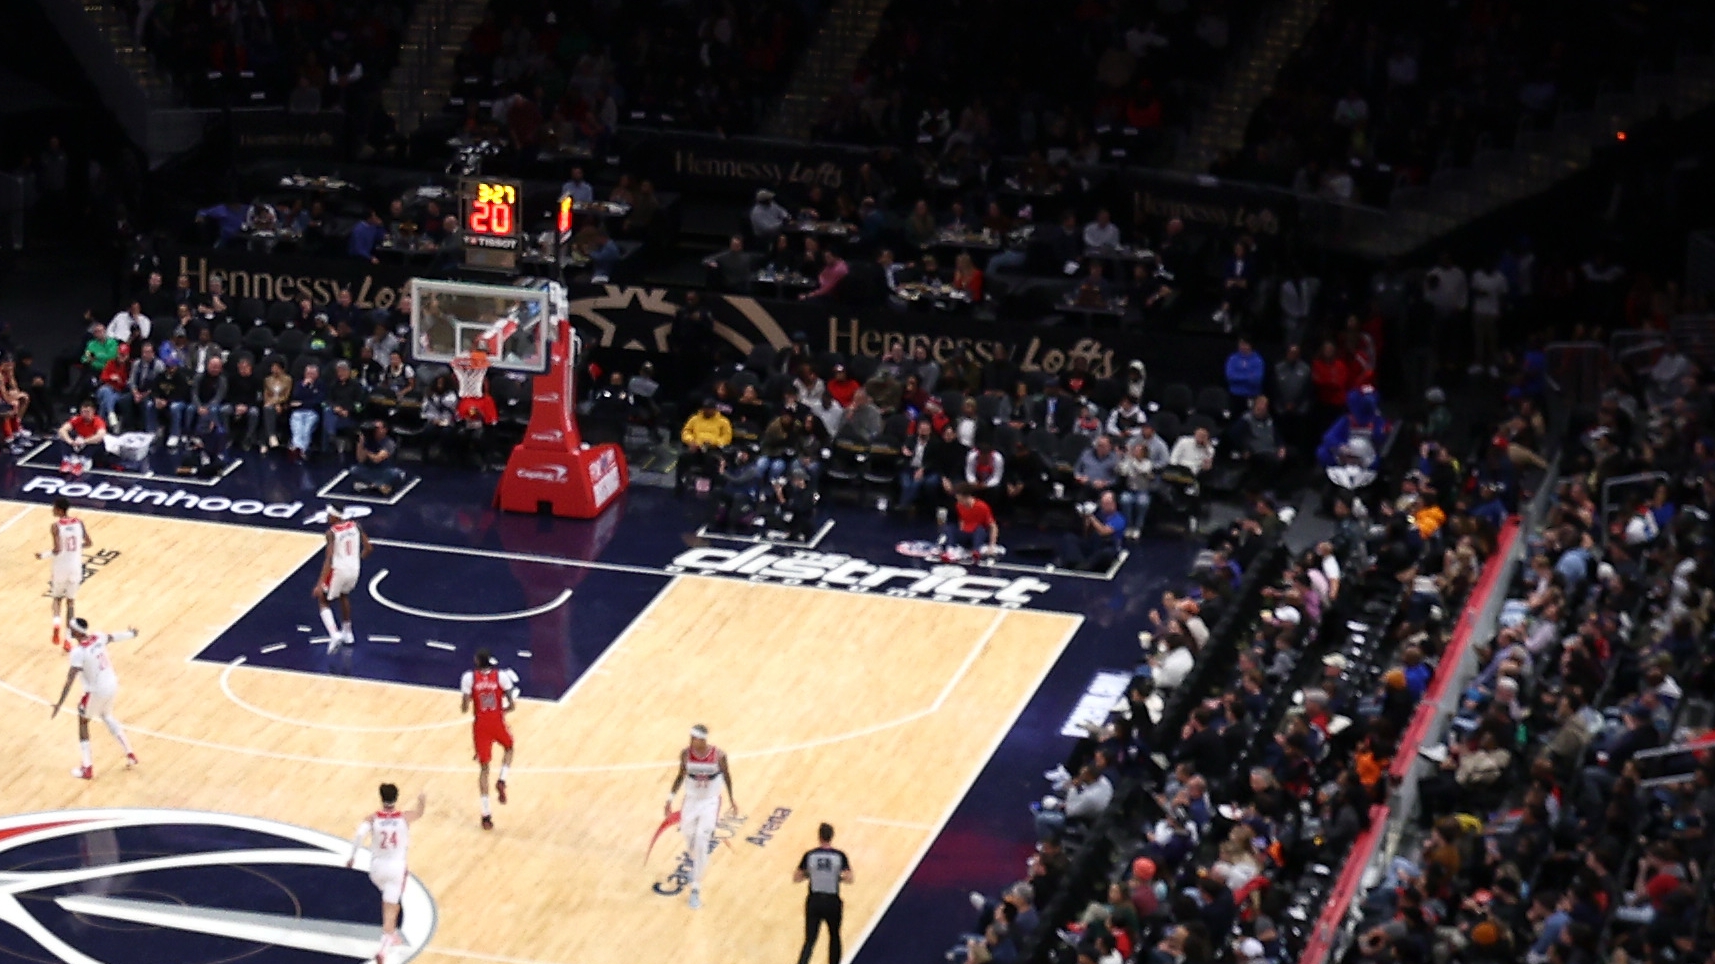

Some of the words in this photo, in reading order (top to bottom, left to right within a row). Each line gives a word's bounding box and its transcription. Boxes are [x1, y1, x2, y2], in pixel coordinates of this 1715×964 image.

[478, 183, 515, 204] 3:27
[470, 200, 512, 234] 20
[22, 475, 304, 519] Robinhood
[672, 544, 1051, 604] district
[380, 831, 397, 849] 24
[745, 806, 794, 847] Arena
